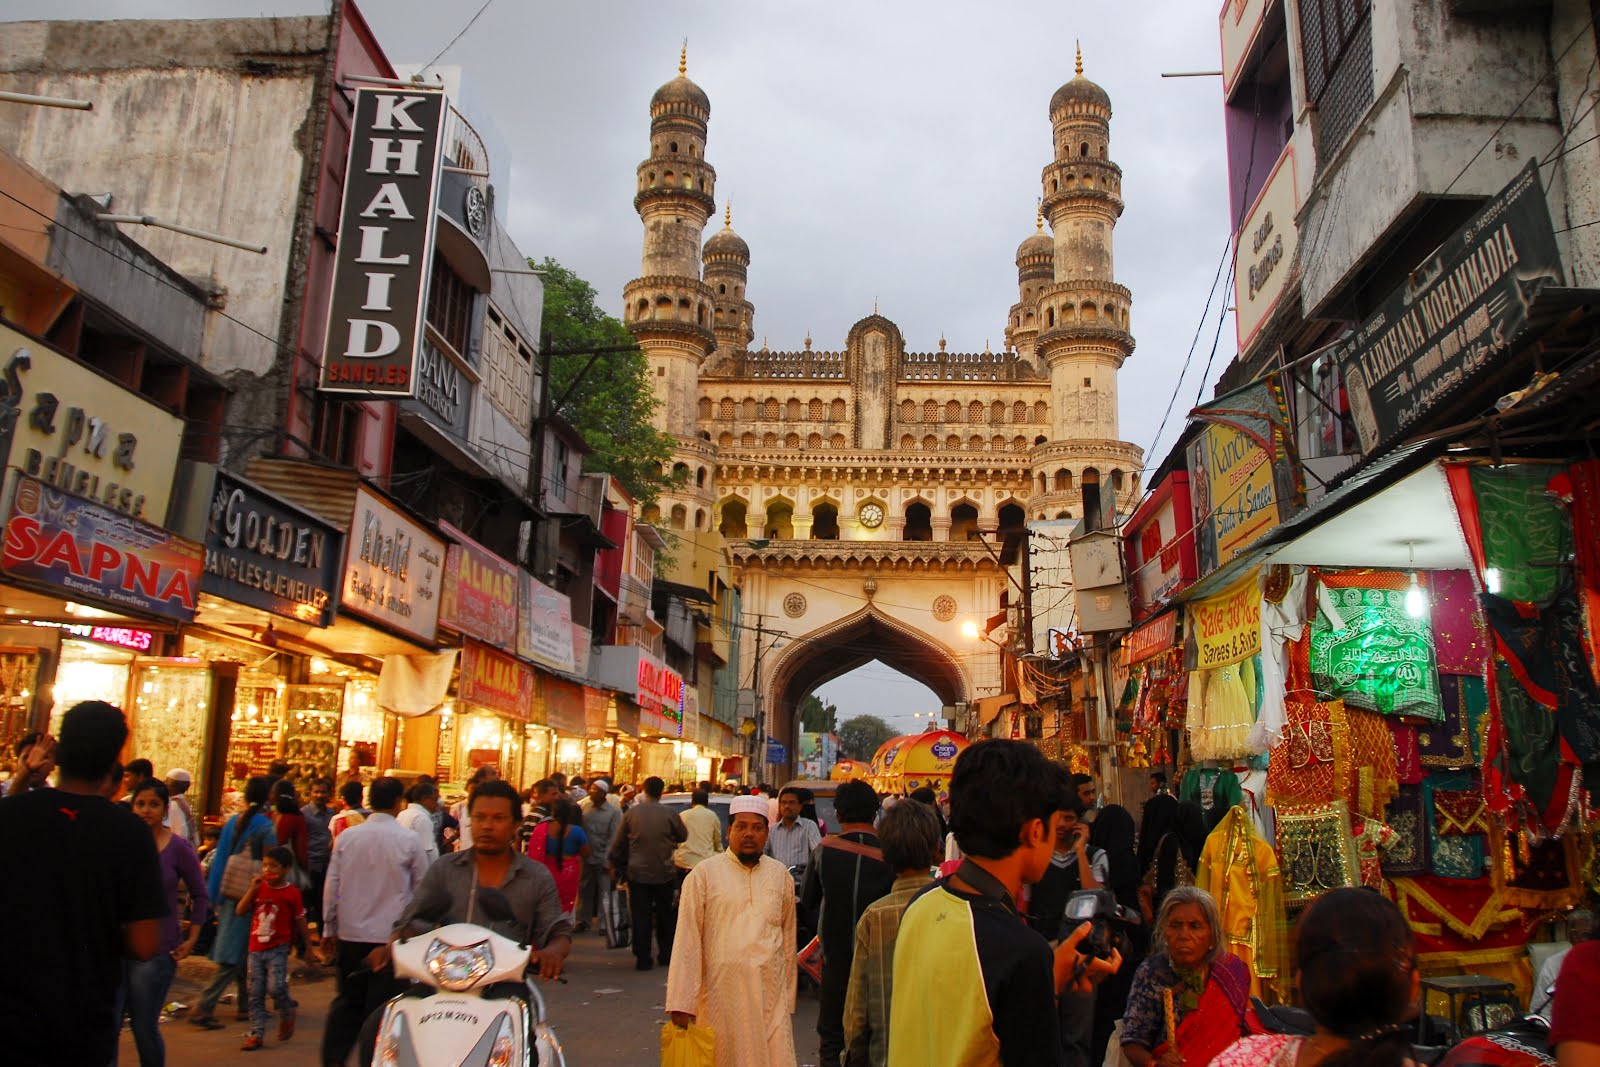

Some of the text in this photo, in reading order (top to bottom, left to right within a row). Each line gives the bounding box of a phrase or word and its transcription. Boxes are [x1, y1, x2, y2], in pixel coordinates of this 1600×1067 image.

[344, 93, 426, 359] KHALID
[1359, 308, 1426, 390] KARKHANA
[1419, 223, 1519, 339] MOHAMMADIA
[327, 361, 408, 386] BANGLES
[224, 488, 326, 569] GOLDEN
[3, 515, 195, 611] SAPNA
[460, 547, 513, 608] ALMAS
[63, 575, 151, 609] Bangles, Jewellers
[92, 626, 152, 650] BANGLES
[1200, 602, 1224, 638] Sale
[1203, 643, 1230, 664] Sarees
[1231, 635, 1238, 658] &
[474, 648, 520, 697] ALMAS
[933, 744, 955, 752] Cream
